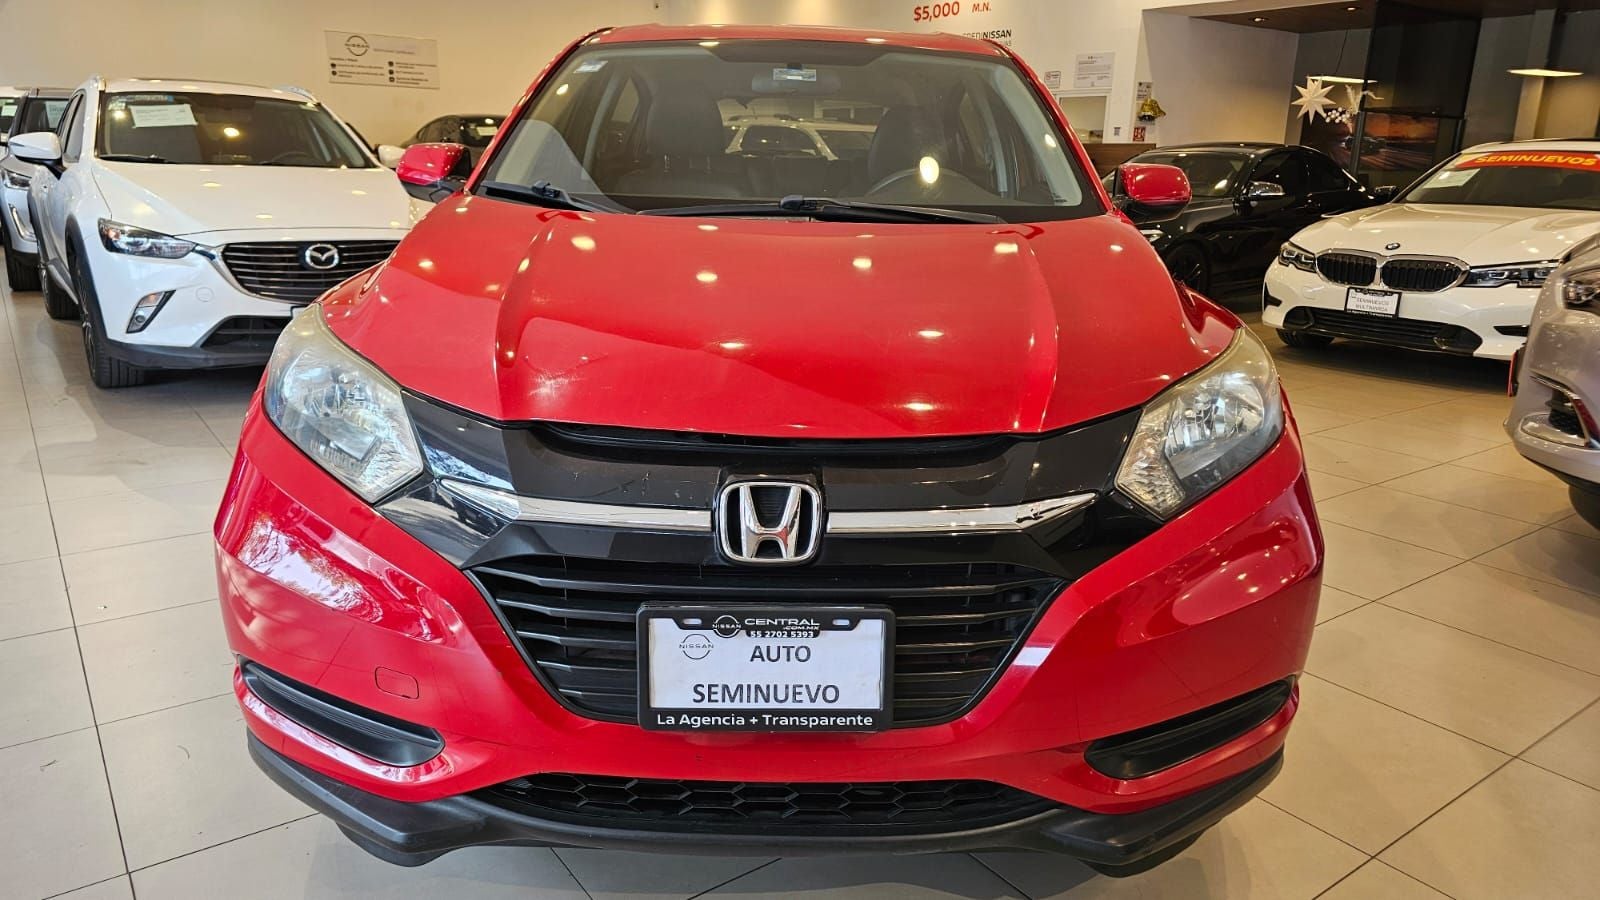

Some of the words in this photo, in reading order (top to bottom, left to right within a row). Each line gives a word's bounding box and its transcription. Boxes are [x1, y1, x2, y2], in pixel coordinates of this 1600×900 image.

[914, 1, 960, 22] $5,000
[972, 2, 992, 13] M.N.
[1475, 154, 1598, 166] SEMINUEVOS
[744, 618, 820, 626] CENTRAL
[750, 645, 812, 663] AUTO
[692, 683, 841, 705] SEMINUEVO
[657, 713, 676, 726] La
[679, 713, 745, 729] Agencia
[749, 716, 759, 726] +
[762, 713, 874, 729] Transparente
